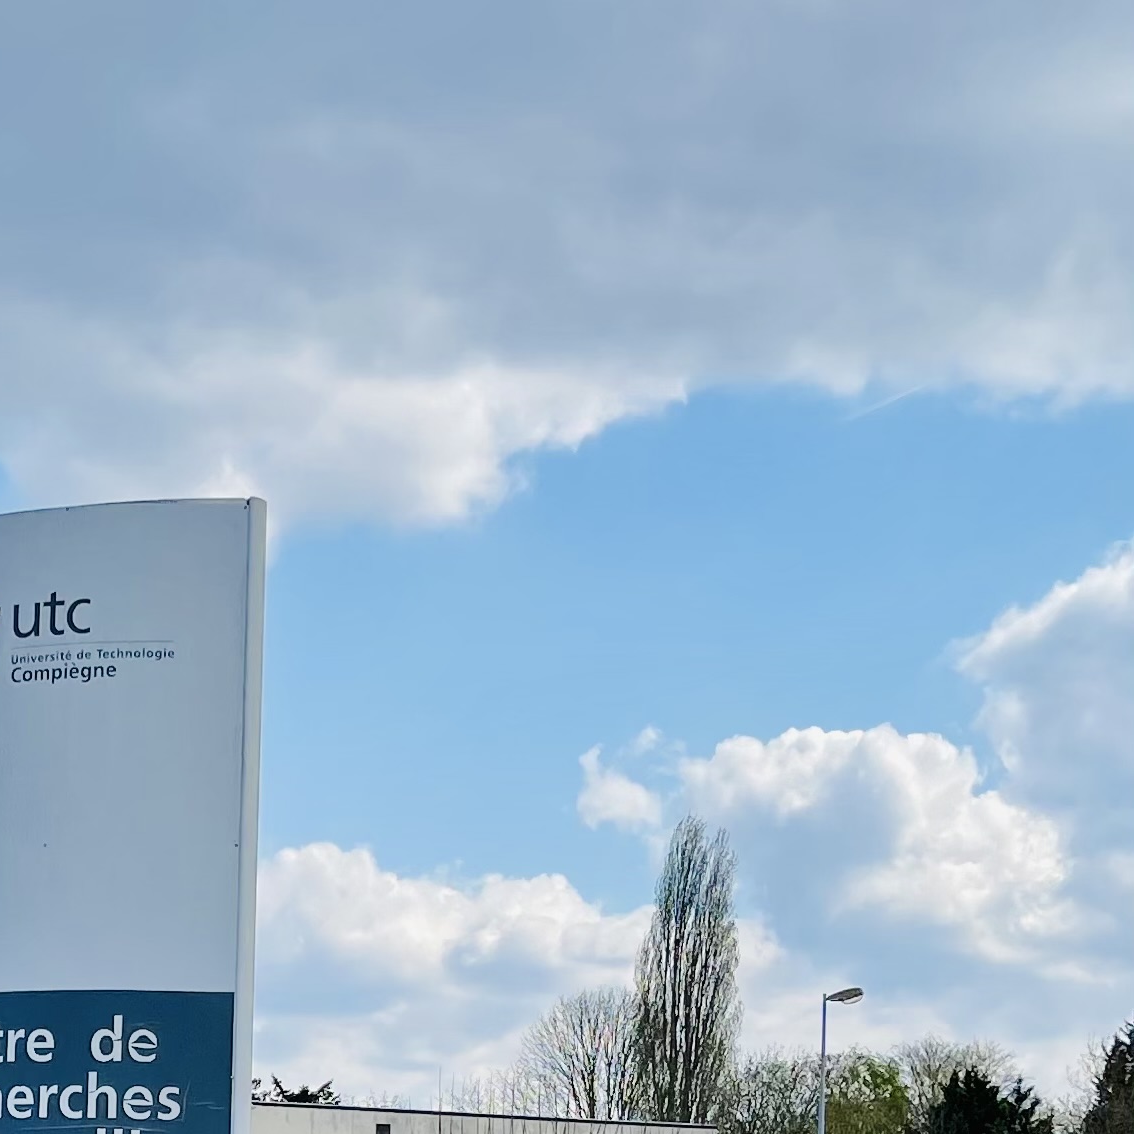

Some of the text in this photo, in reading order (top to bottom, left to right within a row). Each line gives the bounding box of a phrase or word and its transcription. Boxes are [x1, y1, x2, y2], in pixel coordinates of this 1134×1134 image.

[13, 591, 91, 638] utc
[11, 648, 175, 665] Université de Technologie
[11, 662, 117, 684] Compiègne
[90, 1014, 158, 1063] de
